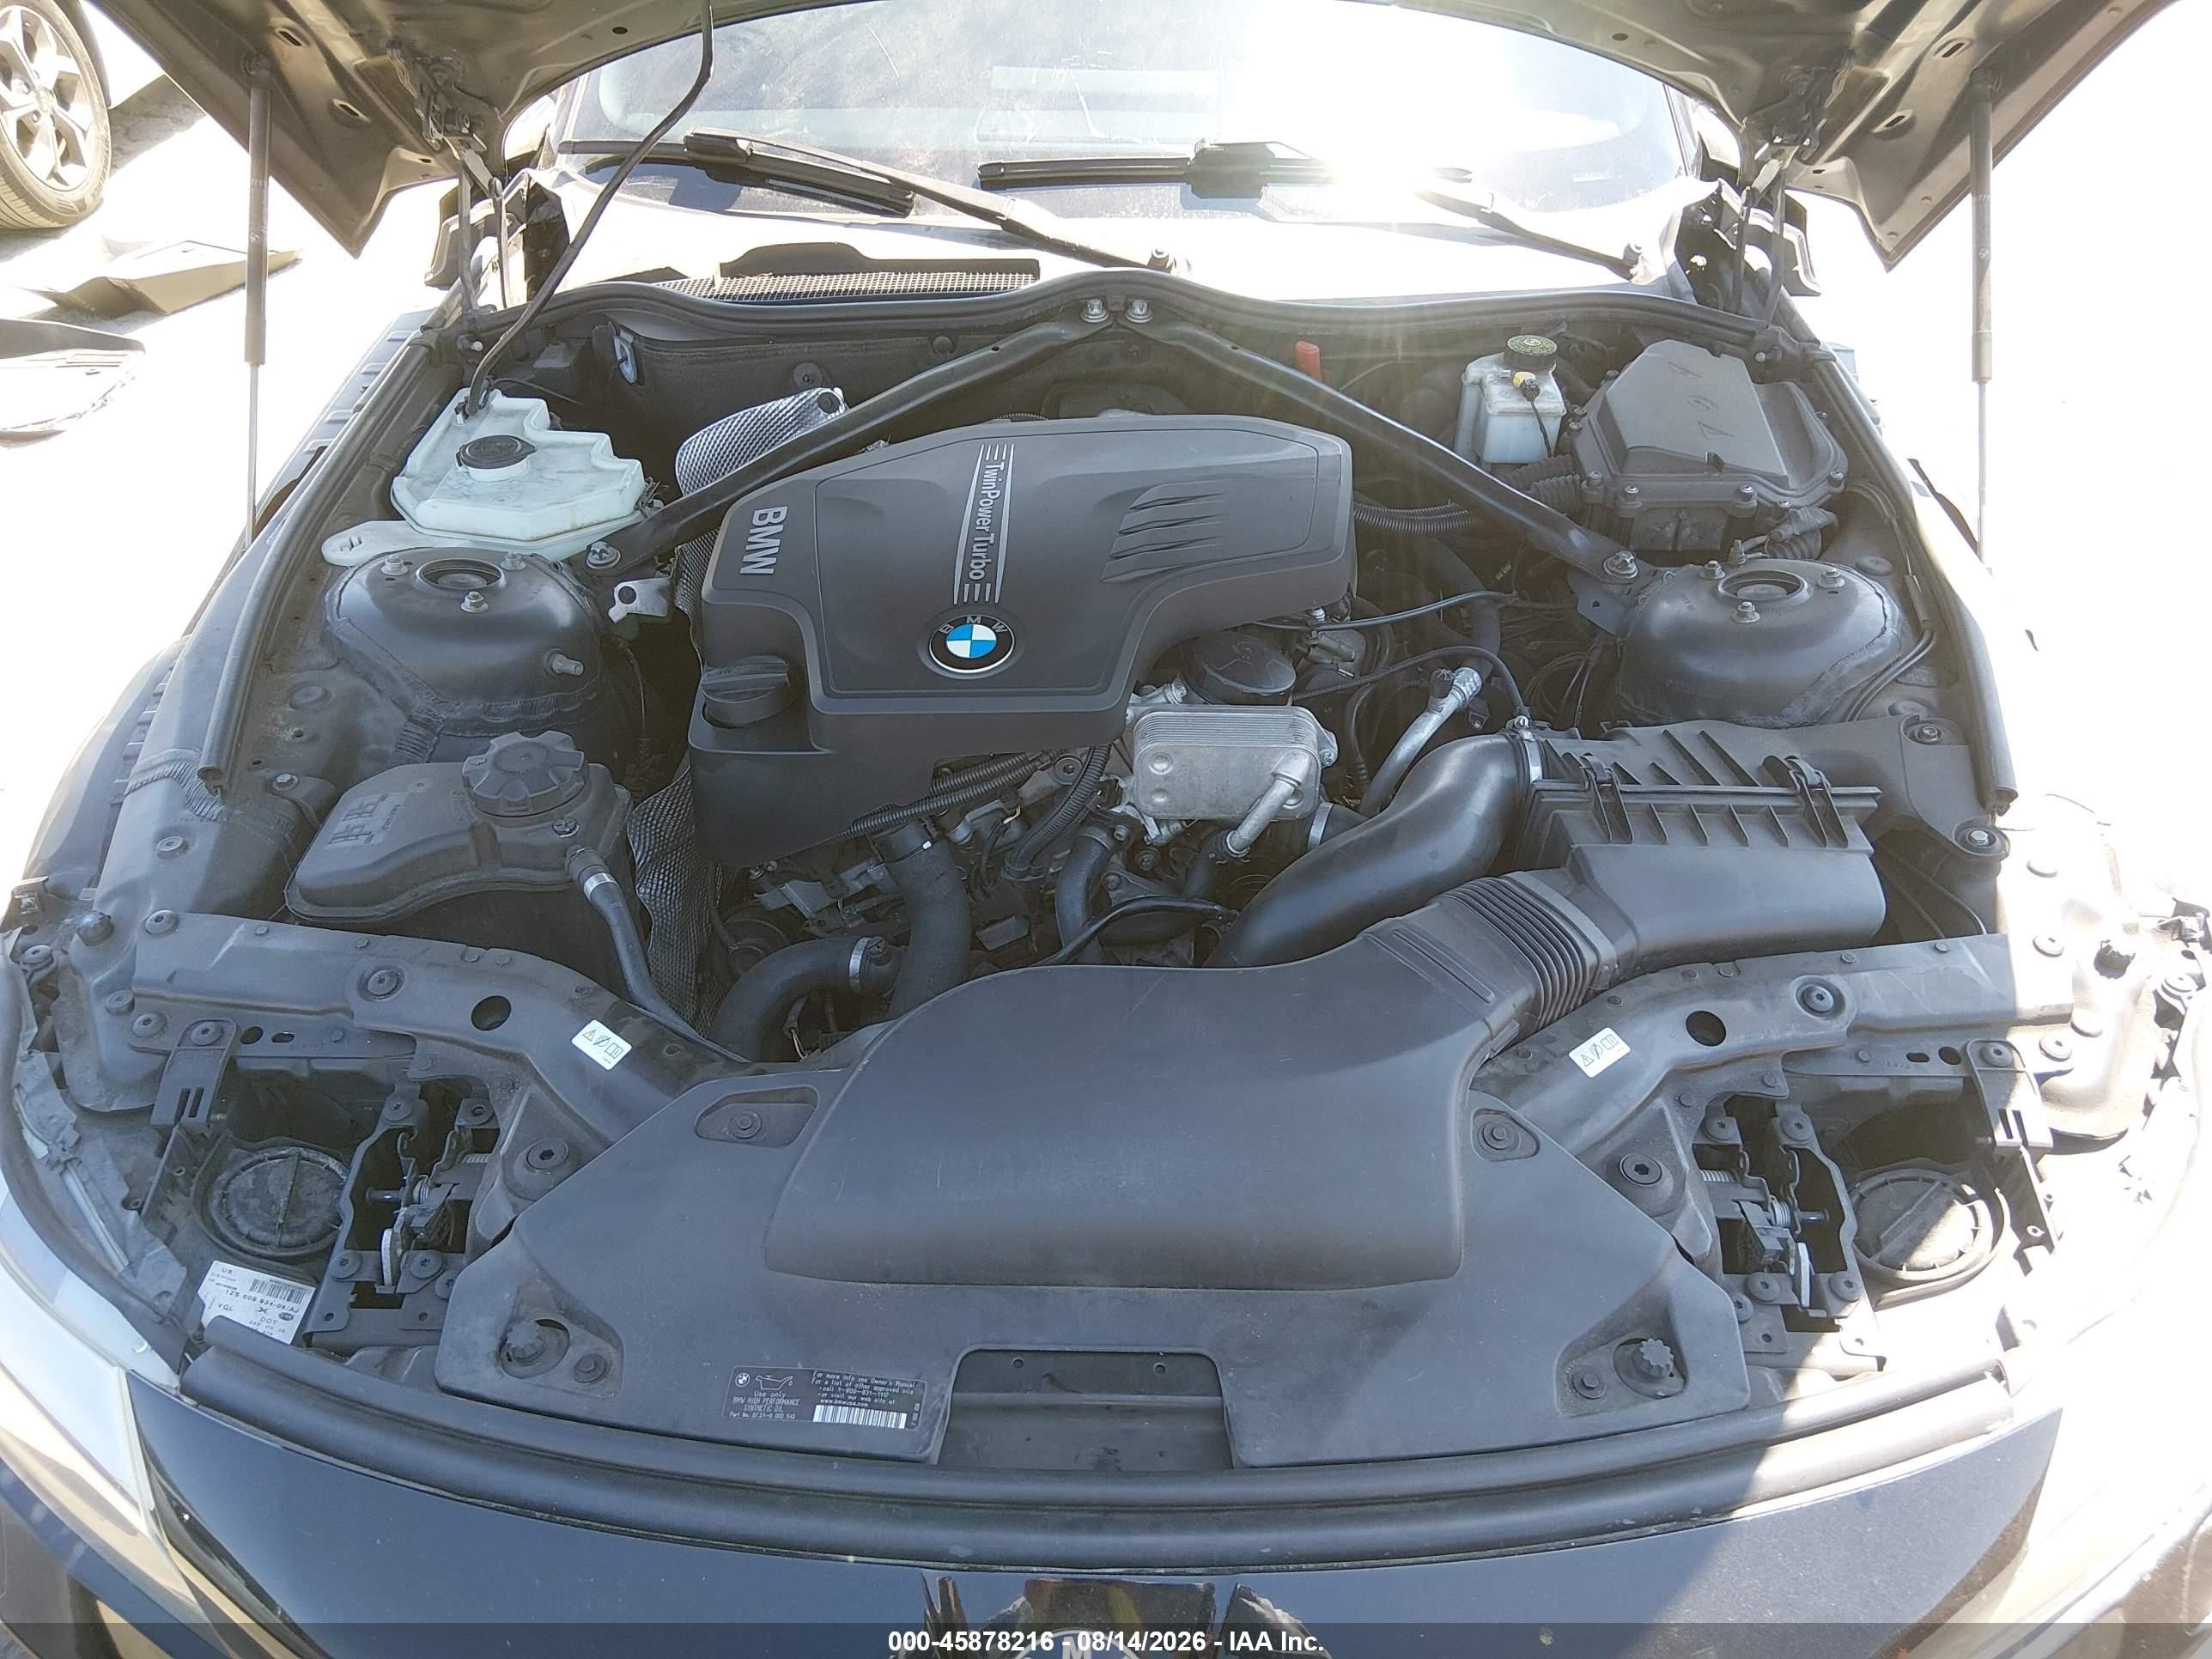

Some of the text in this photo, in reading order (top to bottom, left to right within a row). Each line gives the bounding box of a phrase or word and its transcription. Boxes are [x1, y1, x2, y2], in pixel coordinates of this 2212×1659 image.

[969, 463, 1004, 580] TwinPower Turbo
[740, 506, 788, 575] BMW
[939, 616, 1008, 635] BMW
[260, 1316, 277, 1325] DOT
[895, 1380, 915, 1389] Manual
[769, 1390, 786, 1400] only
[747, 1396, 761, 1405] HIGH
[762, 1397, 800, 1407] PERFORMANCE
[744, 1404, 784, 1413] SYNTHETIC OIL
